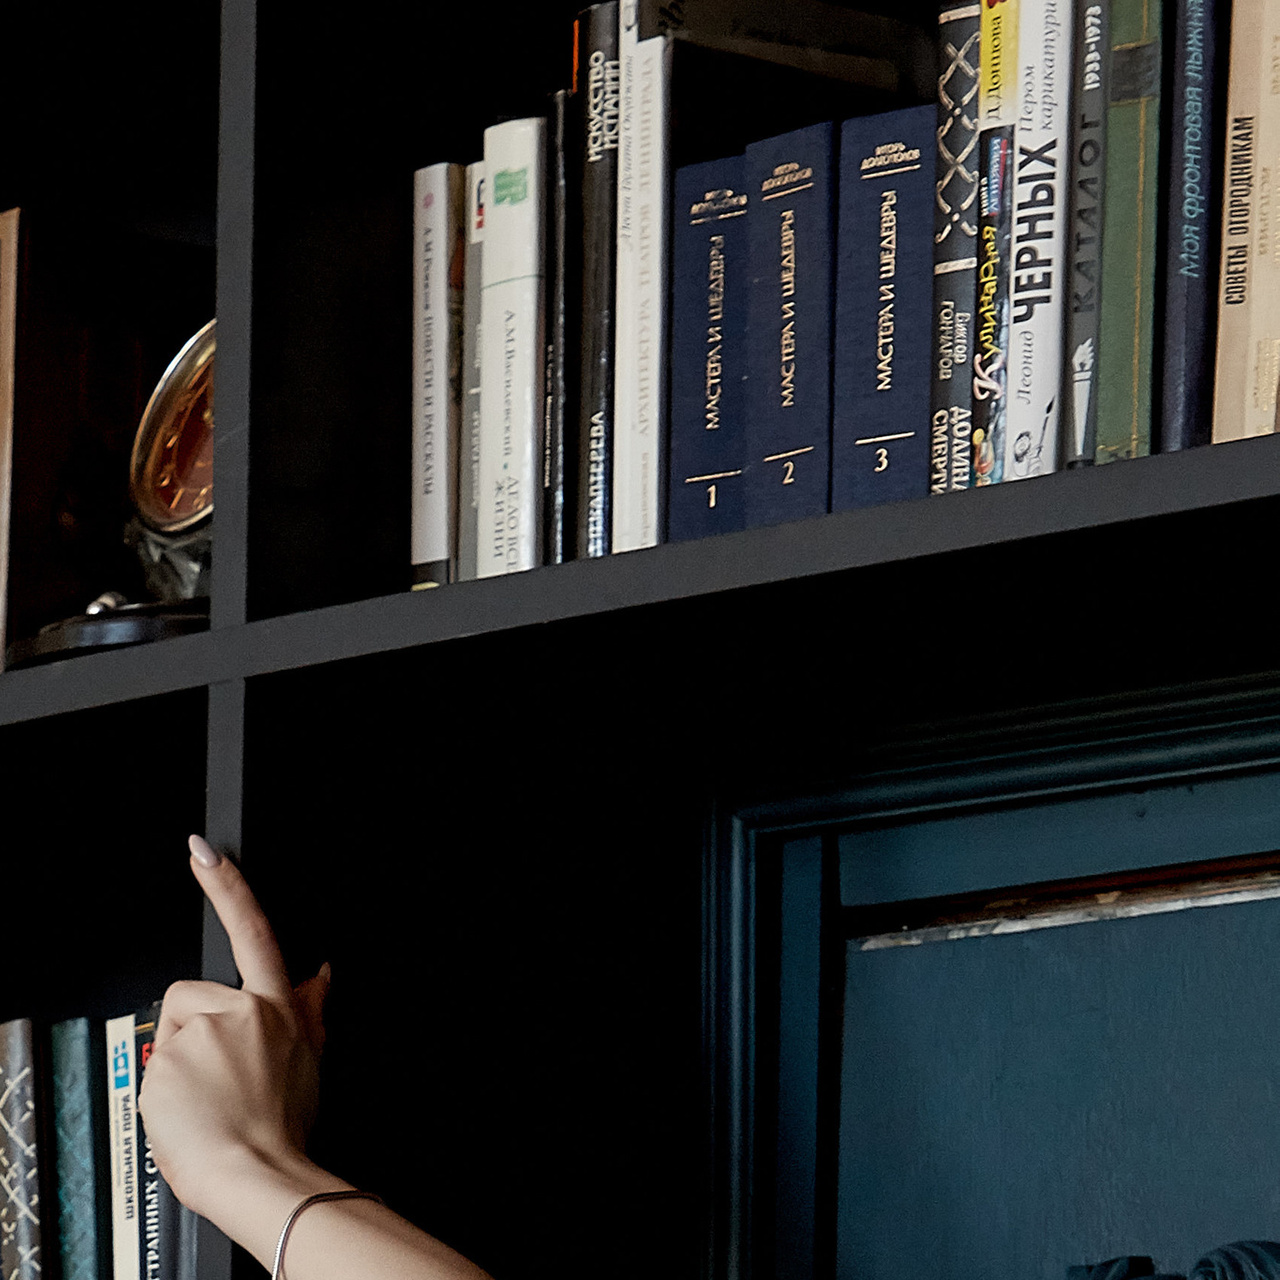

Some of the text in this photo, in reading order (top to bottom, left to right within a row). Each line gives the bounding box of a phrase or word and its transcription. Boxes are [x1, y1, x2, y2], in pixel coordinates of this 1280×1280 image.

[587, 52, 605, 162] ИСКУССТВО
[603, 61, 619, 149] ИСПАНИИ
[640, 57, 653, 191] ЛЕНИНГРАДА
[1019, 65, 1037, 132] Пером
[1182, 87, 1205, 218] фронтовая
[639, 203, 651, 288] ТЕАТРОВ
[1072, 114, 1100, 314] КАТАЛОГ
[1179, 223, 1202, 279] Моя
[1225, 116, 1254, 305] СОВЕТЫ ОГОРОДНИКАМ
[781, 209, 795, 408] МАСТЕРА И ШЕДЕВРЫ
[876, 190, 898, 390] МАСТЕРА И ШЕДЕВРЫ
[1012, 138, 1058, 405] Леонид ЧЕРНЫХ
[423, 316, 435, 389] ПОВЕСТИ
[637, 297, 652, 437] АРХИТЕКТУРА
[705, 235, 724, 431] МАСТЕРА И ШЕДЕВРЫ
[939, 301, 956, 381] ГОНЧАРОВ
[955, 311, 971, 364] Виктор
[423, 396, 435, 408] И
[422, 413, 434, 497] РАССКАЗЫ
[707, 485, 716, 508] 1
[782, 461, 794, 485] 2
[874, 448, 889, 472] 3
[492, 482, 507, 559] ЖИЗНИ
[505, 478, 520, 532] ДЕЛО
[120, 1093, 135, 1221] ШКОЛЬНАЯ ПОРА
